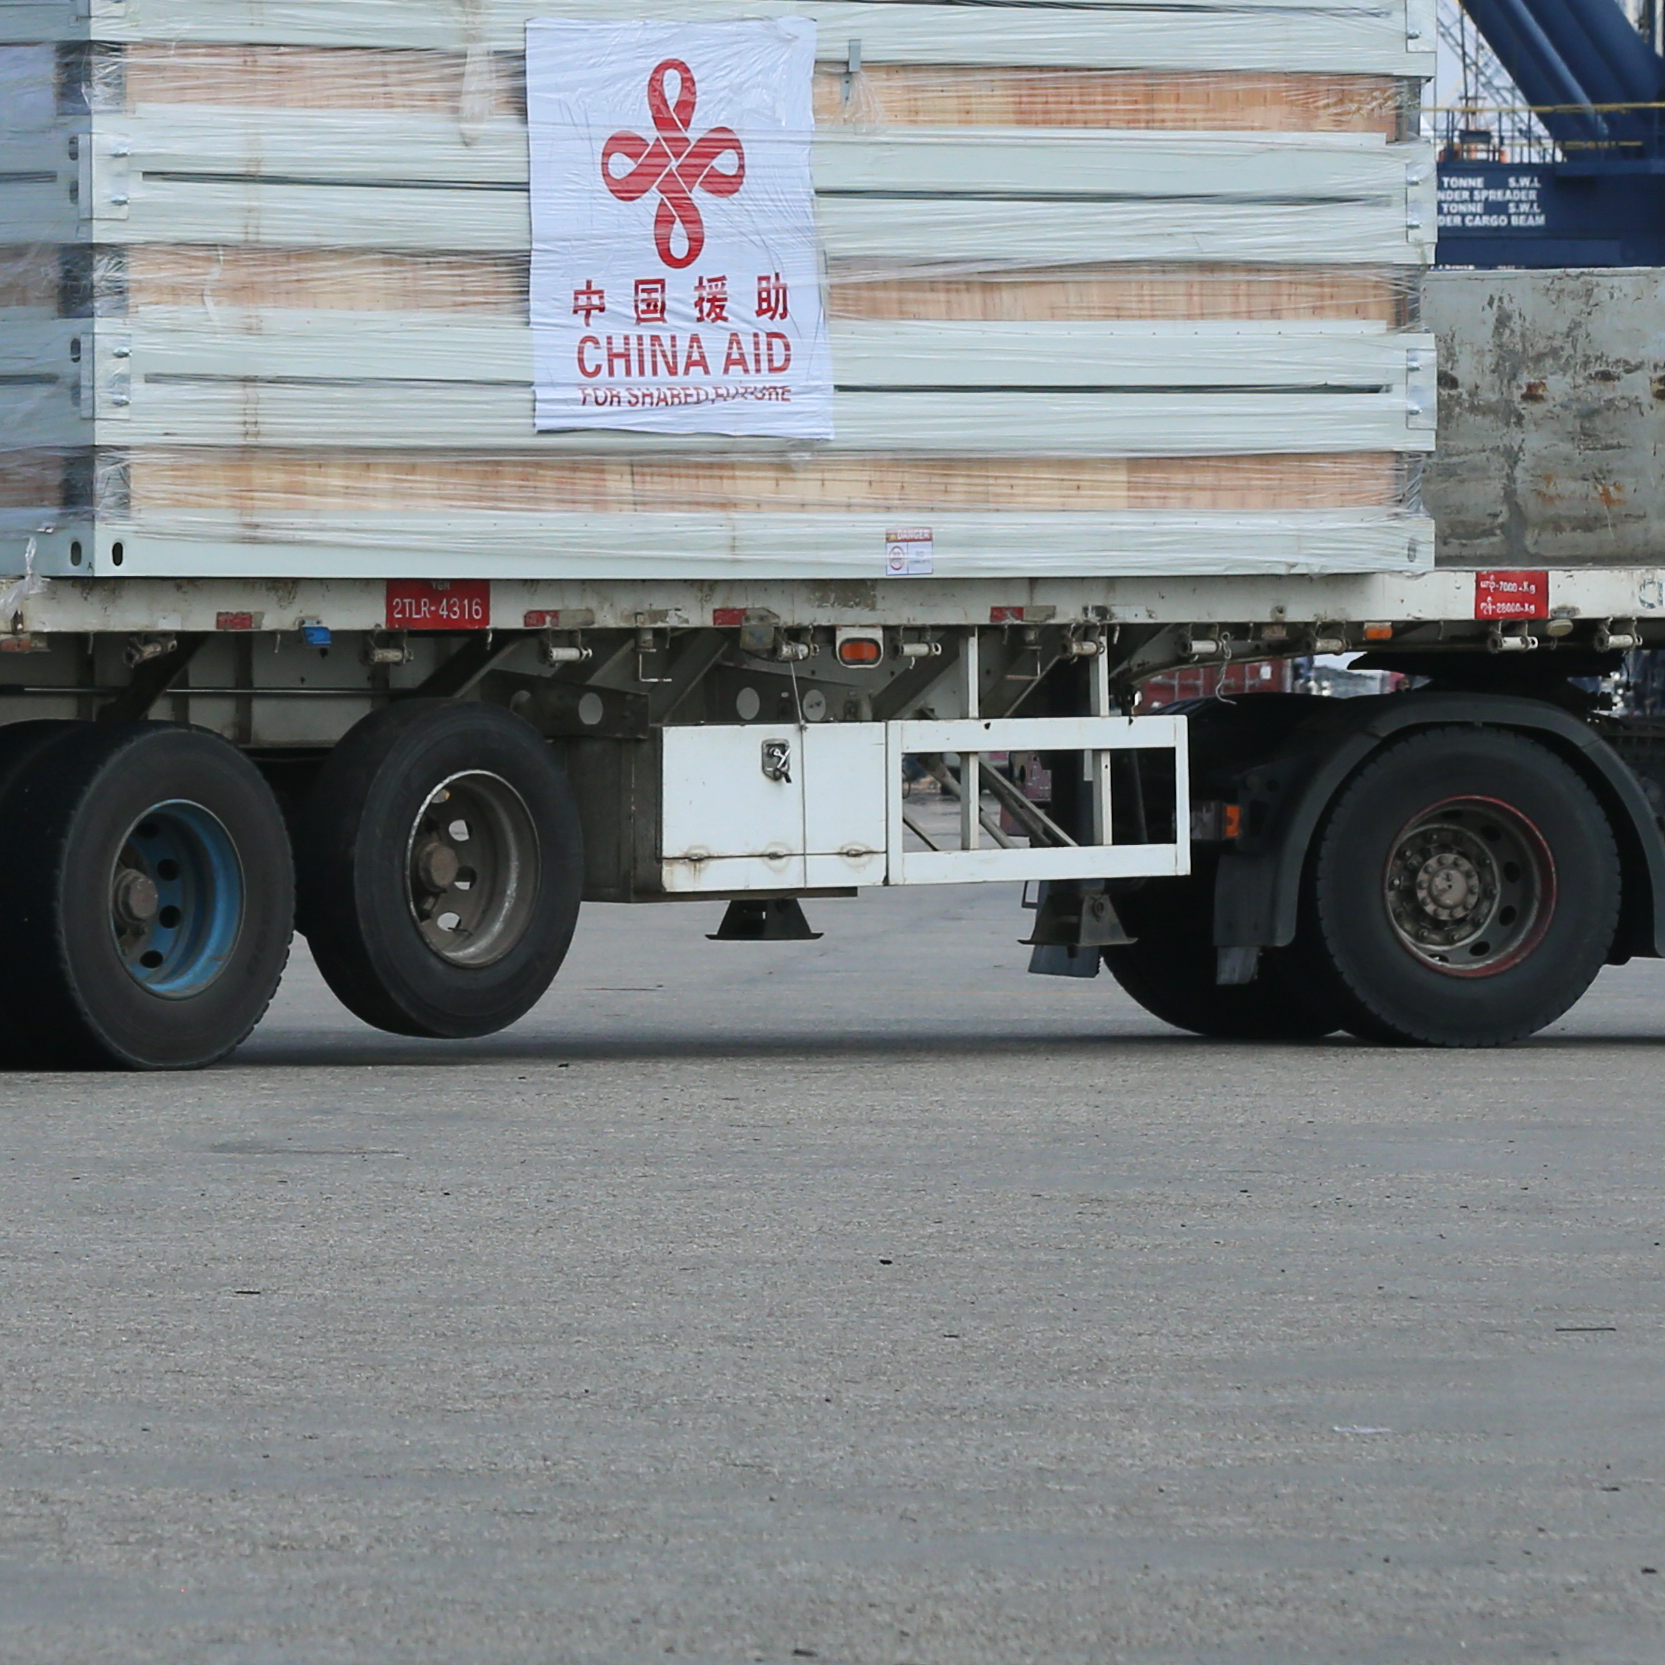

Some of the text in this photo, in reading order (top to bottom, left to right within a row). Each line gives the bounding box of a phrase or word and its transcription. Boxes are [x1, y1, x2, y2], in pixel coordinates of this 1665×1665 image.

[1441, 177, 1484, 188] TONNE
[1438, 189, 1537, 201] NDER SPREADER
[1441, 202, 1484, 213] TONNE
[1438, 215, 1546, 226] DER CARGO BEAM
[572, 272, 789, 327] 中国援助
[577, 331, 792, 378] CHINA AID
[579, 386, 621, 407] FOR
[627, 386, 709, 407] SHARED
[393, 598, 483, 619] 2TLR-4316
